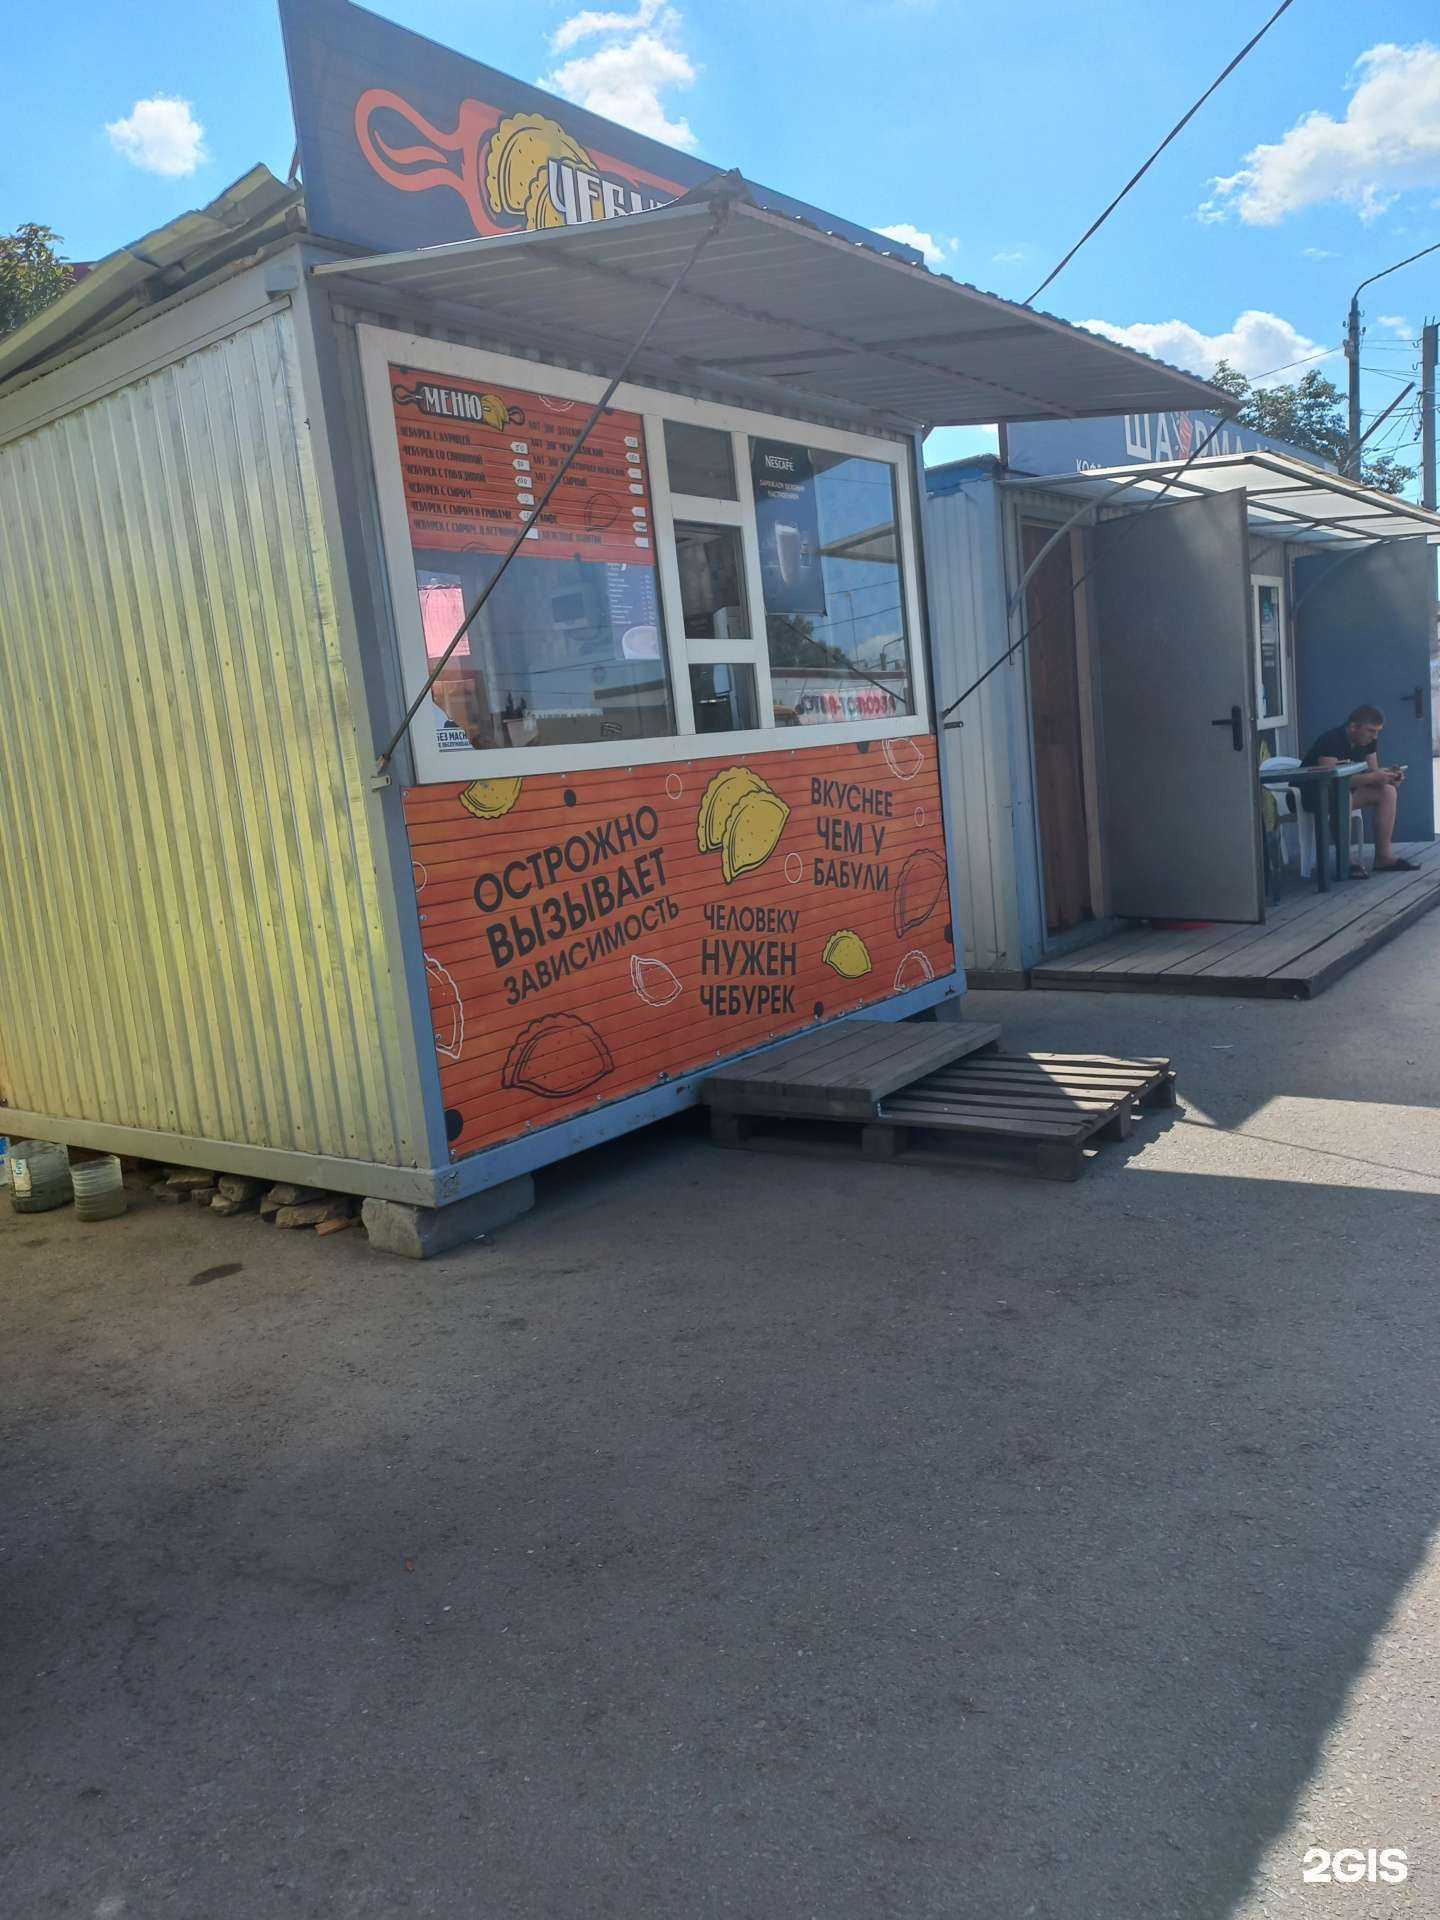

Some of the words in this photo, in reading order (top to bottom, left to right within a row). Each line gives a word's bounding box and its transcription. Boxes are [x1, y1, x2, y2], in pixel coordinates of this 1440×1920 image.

[424, 386, 482, 420] МЕНЮ
[811, 777, 893, 817] ВКУСНЕЕ
[816, 816, 863, 854] ЧЕМ
[872, 824, 885, 855] У
[474, 806, 658, 912] ОСТРОЖНО
[813, 858, 889, 891] БАБУЛИ
[487, 847, 666, 968] ВЫЗЫВАЕТ
[703, 904, 800, 933] ЧЕЛОВЕКУ
[504, 896, 679, 1005] ЗАВИСИМОСТЬ
[702, 939, 796, 976] НУЖЕН
[700, 984, 795, 1016] ЧЕБУРЕК
